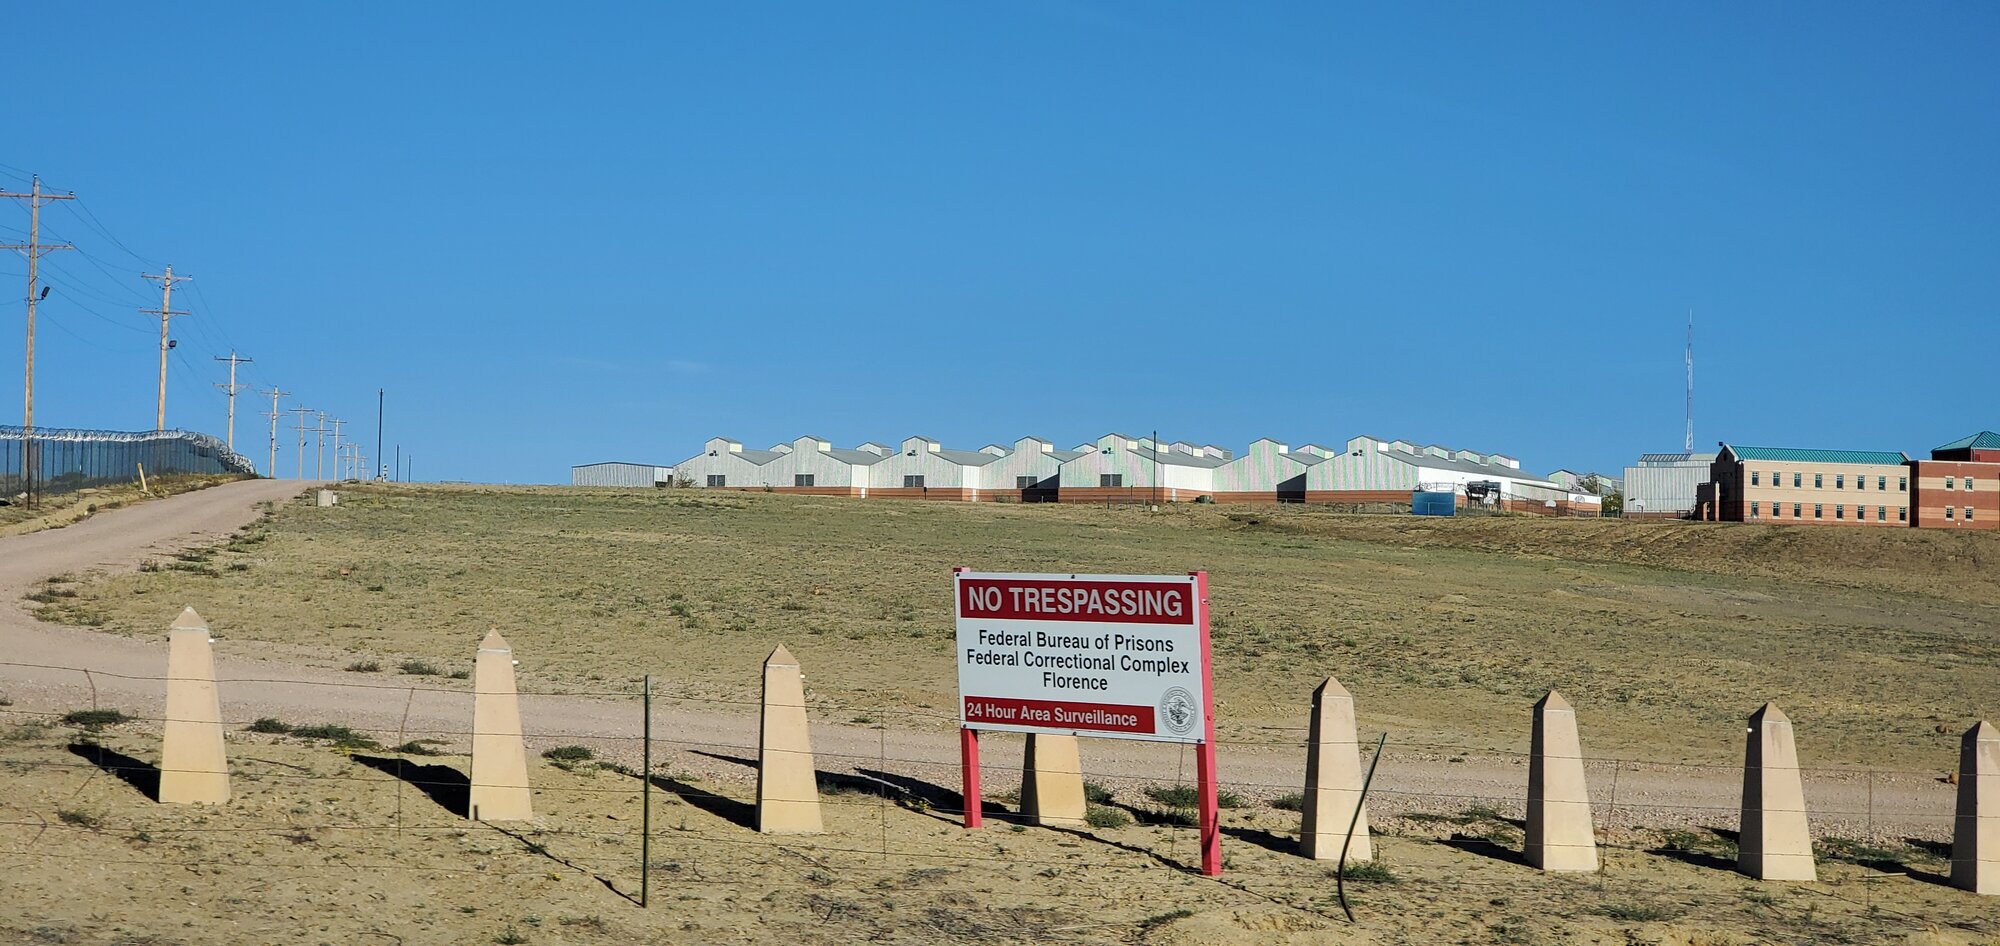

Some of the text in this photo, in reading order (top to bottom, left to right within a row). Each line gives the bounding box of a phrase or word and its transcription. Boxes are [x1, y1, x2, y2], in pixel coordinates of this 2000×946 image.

[968, 586, 1183, 617] NO TRESPASSING
[979, 629, 1174, 652] Federal Bureau of Prisons
[967, 649, 1190, 676] Federal Correctional Complex
[1043, 672, 1108, 691] Florence
[967, 703, 1137, 727] 24 Hour Area Surveillance
